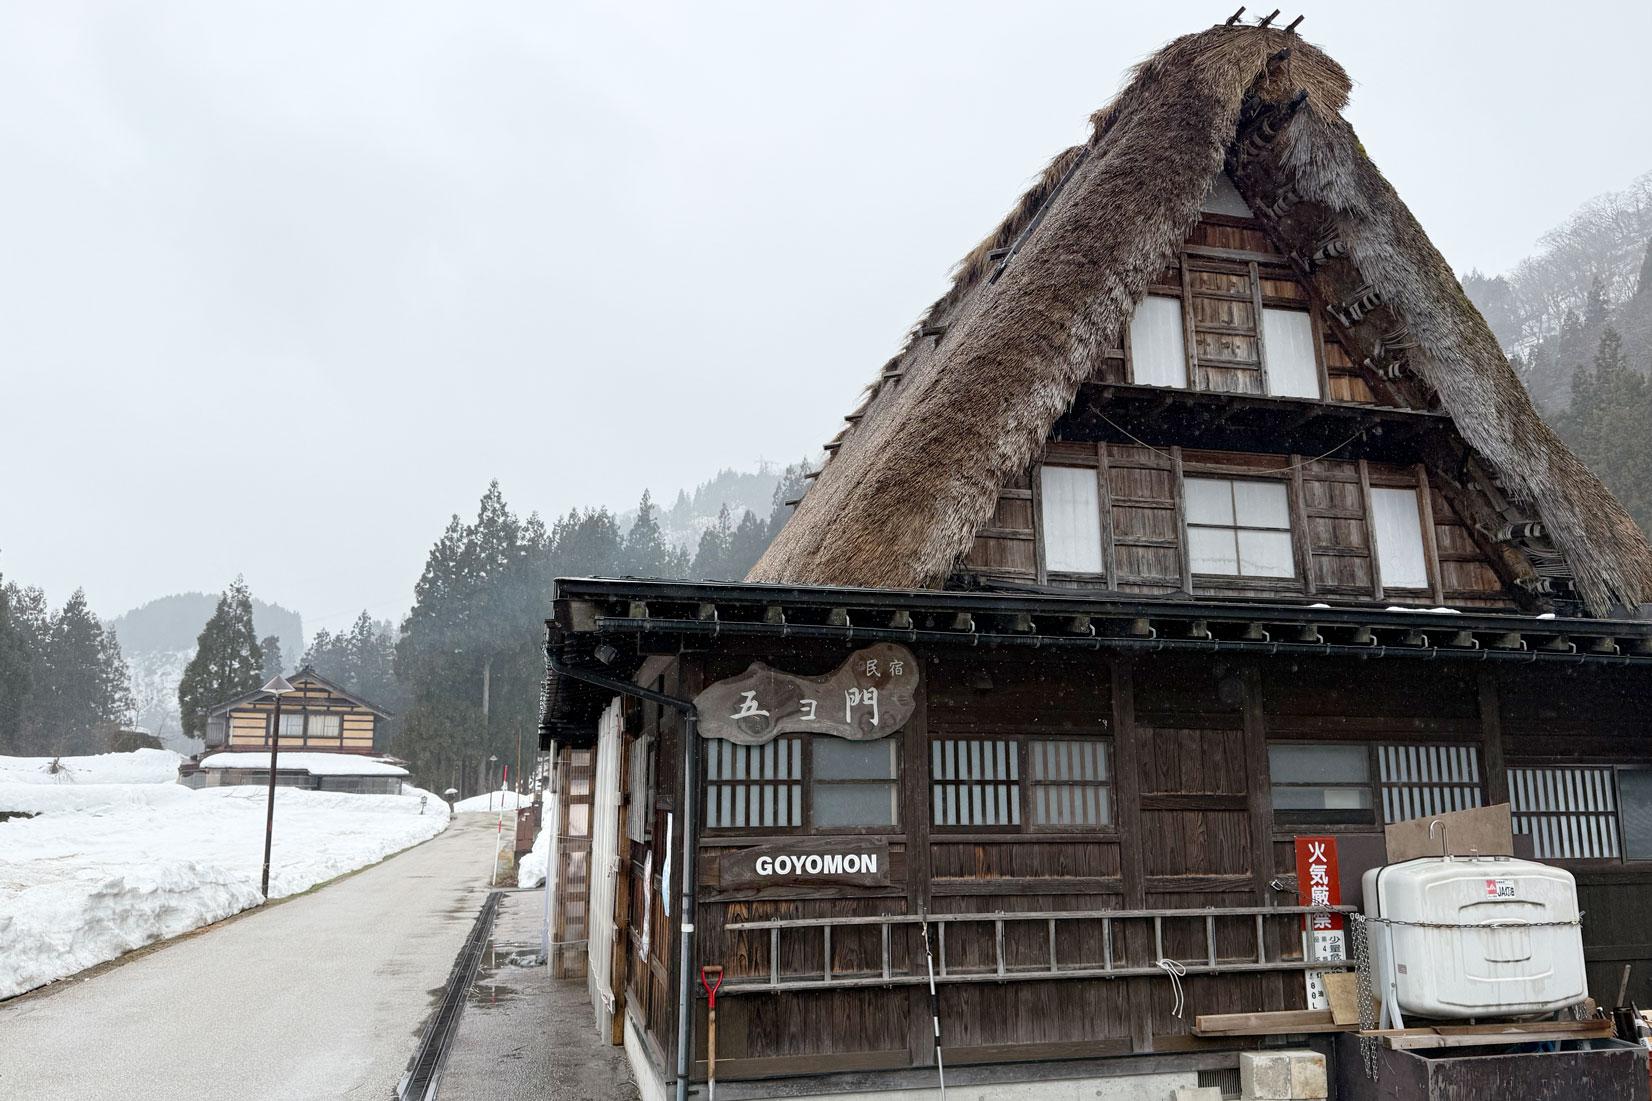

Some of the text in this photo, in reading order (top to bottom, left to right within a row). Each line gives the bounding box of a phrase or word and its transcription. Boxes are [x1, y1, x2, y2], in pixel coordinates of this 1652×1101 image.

[865, 659, 904, 677] 民宿
[755, 853, 878, 876] GOYOMON
[1308, 841, 1333, 929] 火気厳禁
